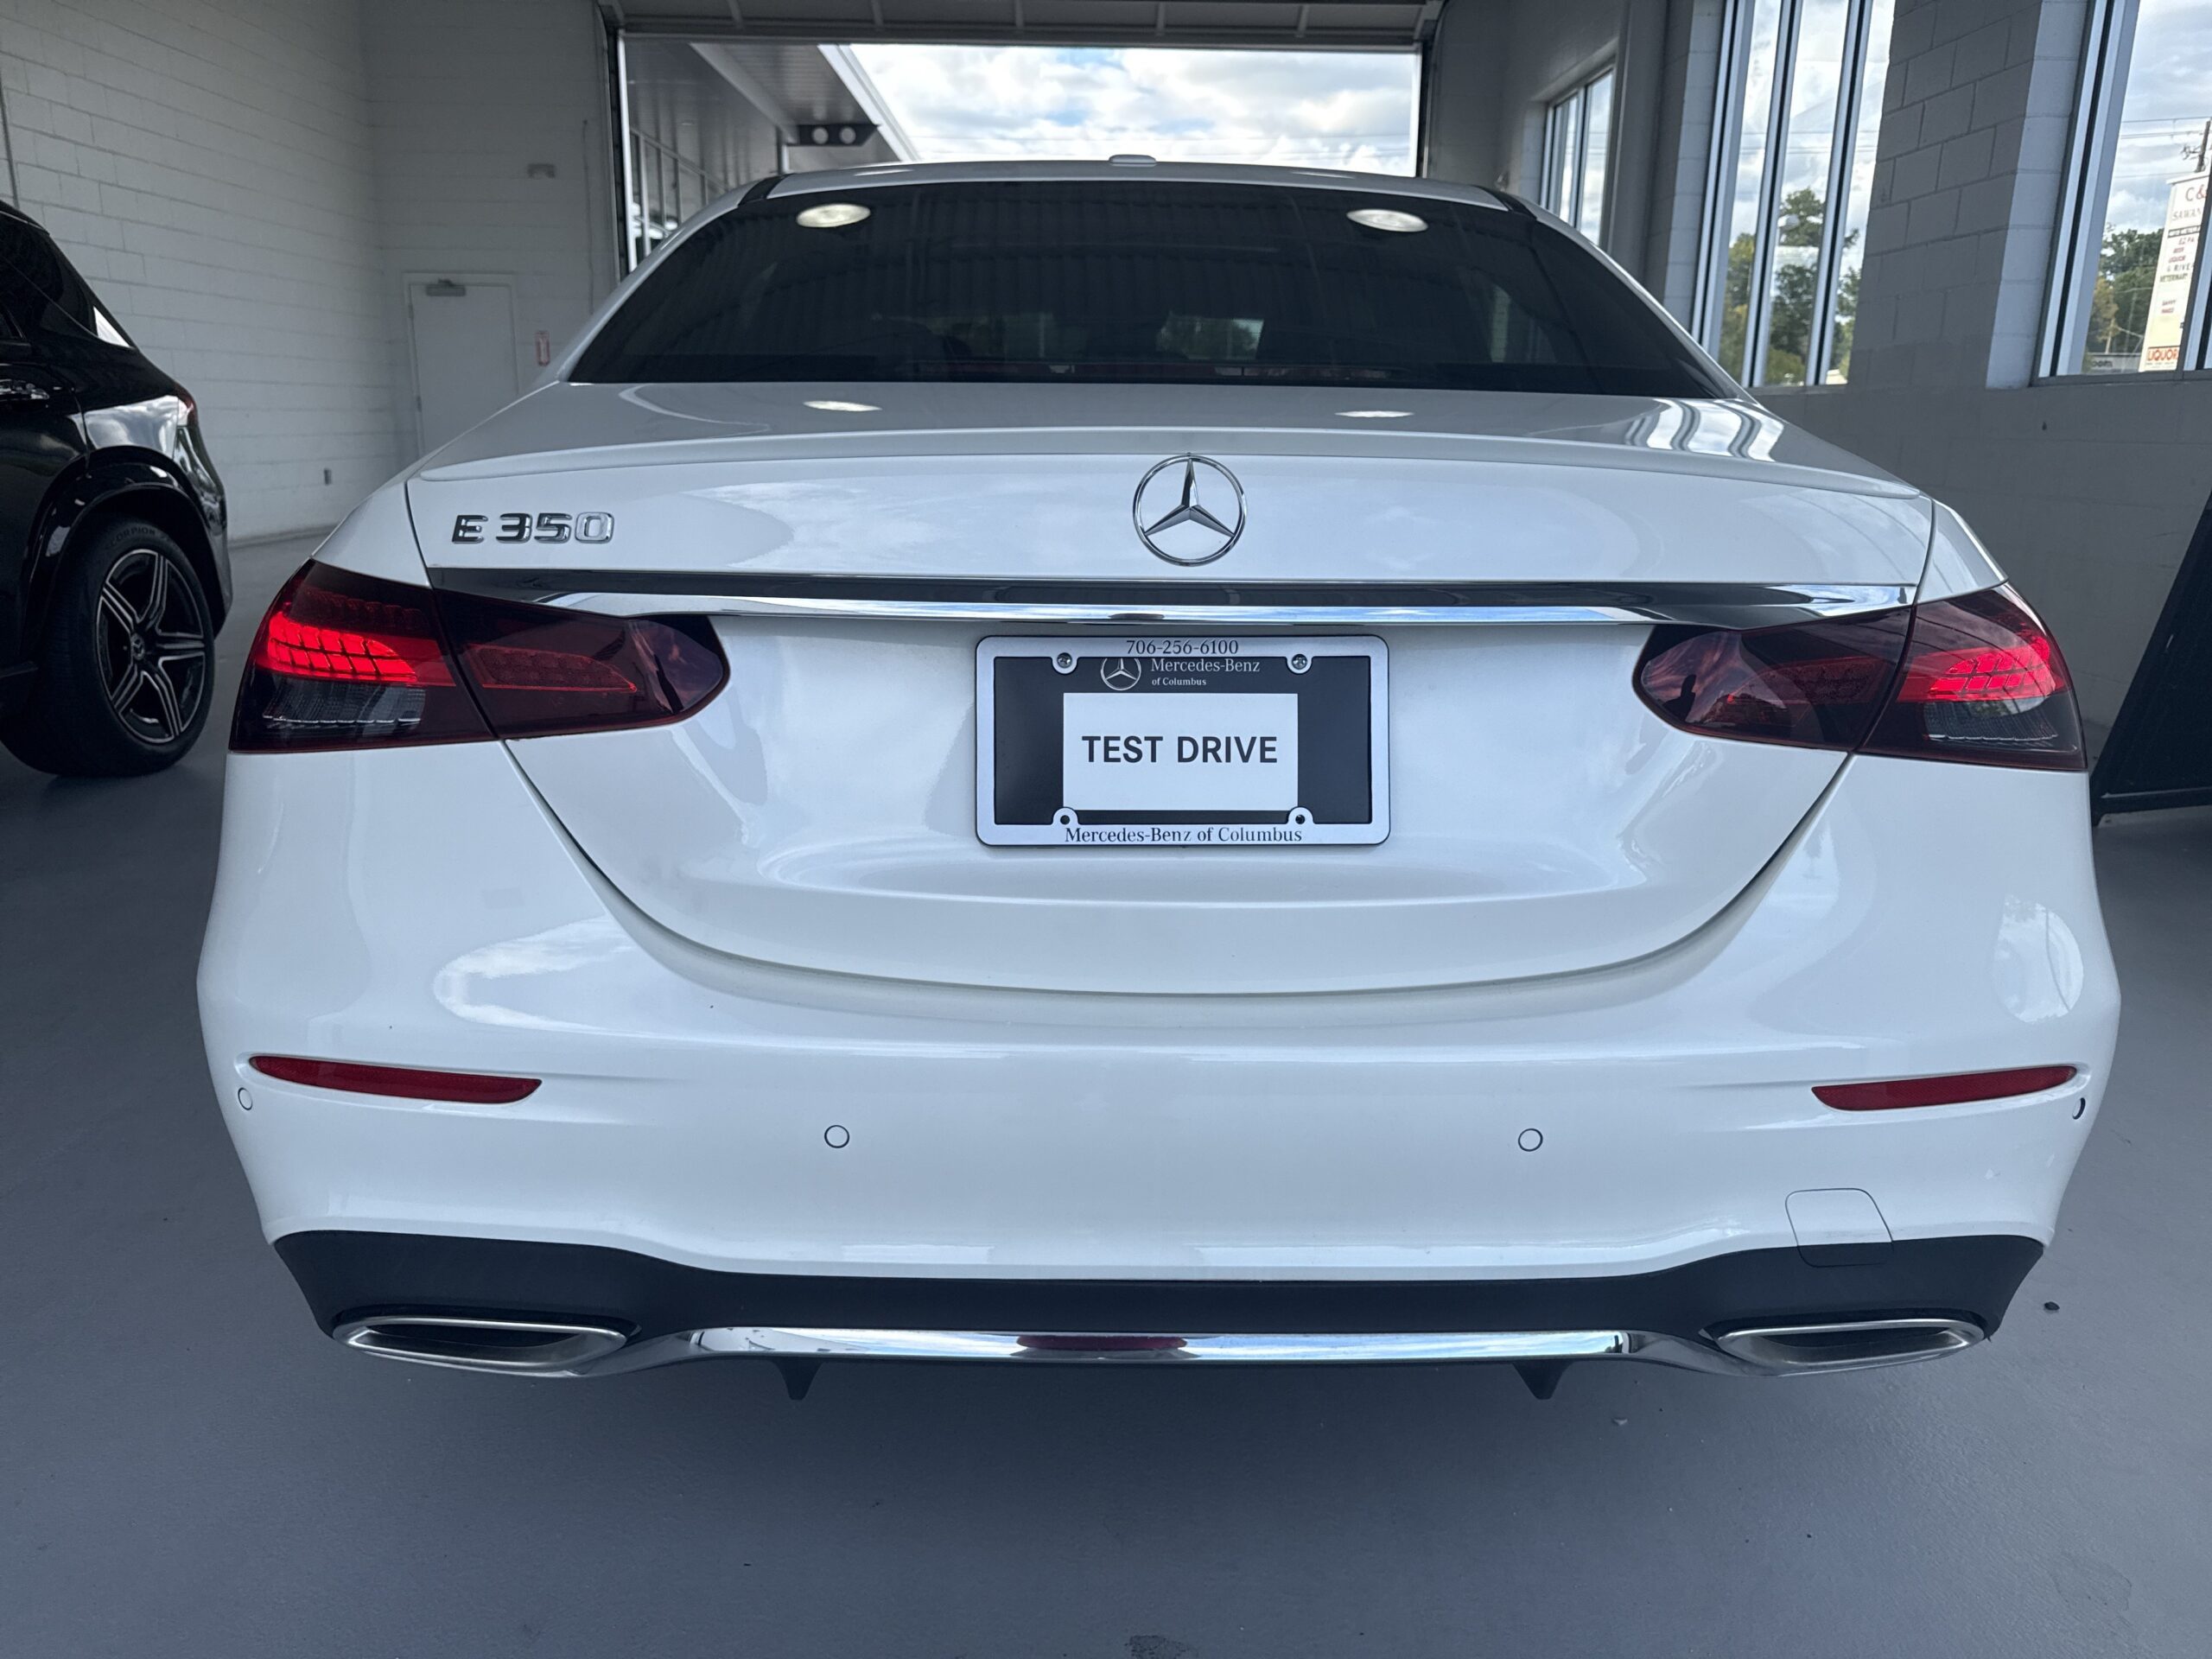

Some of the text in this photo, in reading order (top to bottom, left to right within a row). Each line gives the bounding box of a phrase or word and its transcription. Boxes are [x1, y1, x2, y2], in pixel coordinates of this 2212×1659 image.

[452, 512, 614, 543] E 350
[1126, 639, 1239, 655] 706-256-6100
[1151, 658, 1260, 672] Mercedes-Benz
[1152, 677, 1207, 686] of Columbus
[1082, 735, 1278, 763] TEST DRIVE
[1065, 827, 1302, 842] Mercedes-Benz of Columbus
